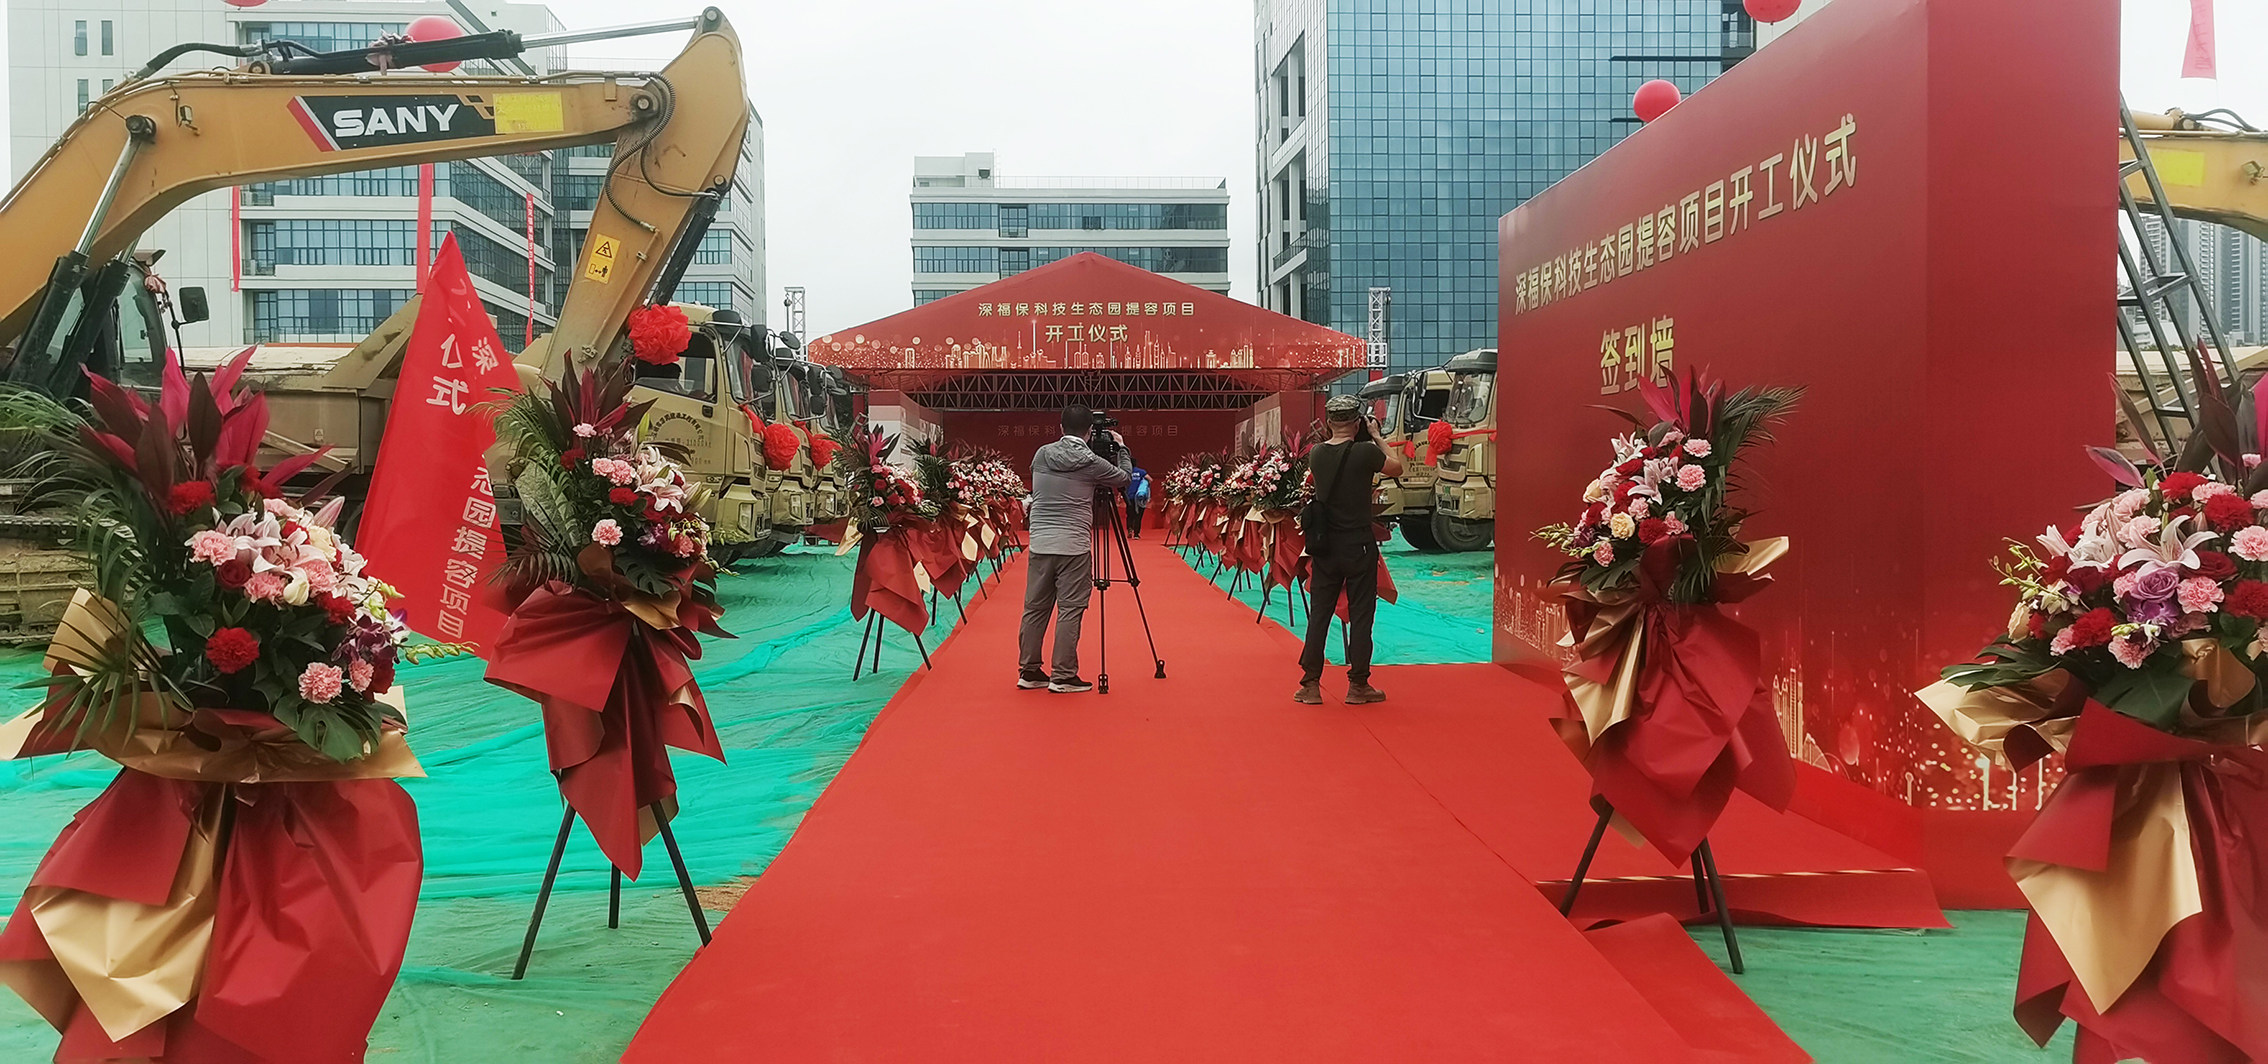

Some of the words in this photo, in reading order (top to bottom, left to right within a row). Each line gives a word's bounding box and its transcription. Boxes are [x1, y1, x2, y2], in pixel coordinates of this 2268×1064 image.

[333, 104, 459, 138] SANY
[1514, 113, 1858, 316] 深福保科技生态园提容项目开工仪式
[978, 302, 1195, 317] 深福保科技生态园提容项目
[1045, 324, 1129, 343] 开工仪式
[1600, 314, 1675, 395] 签到墙
